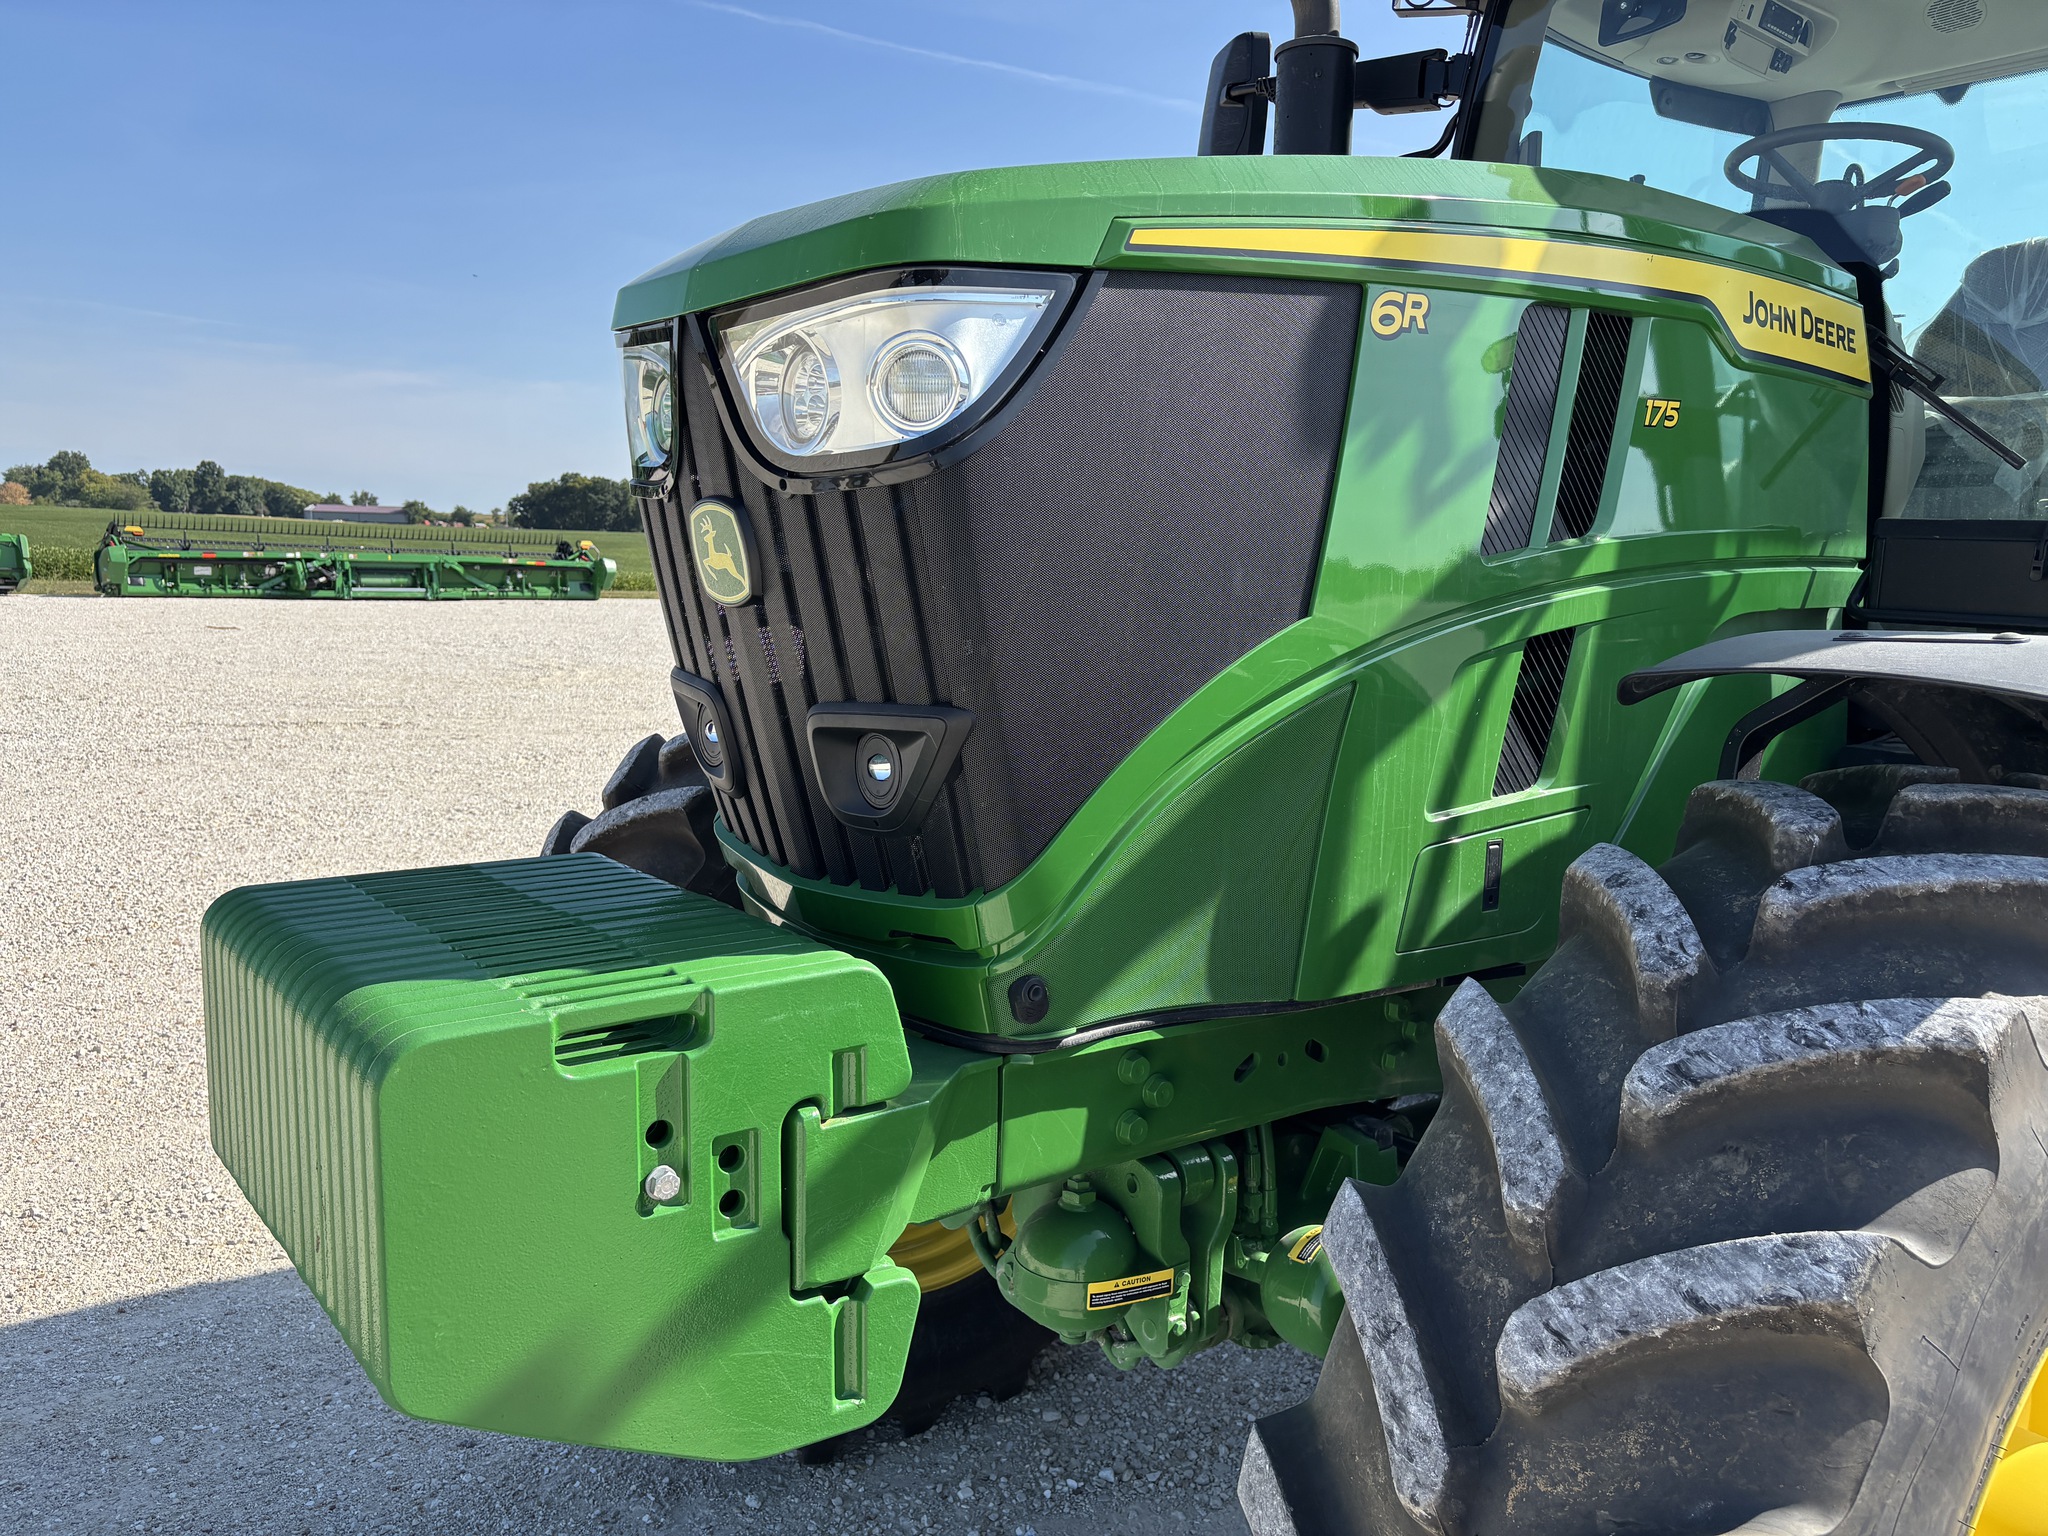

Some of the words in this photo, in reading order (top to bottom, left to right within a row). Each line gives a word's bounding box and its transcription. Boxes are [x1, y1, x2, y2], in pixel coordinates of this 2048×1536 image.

[1370, 290, 1430, 340] 6R
[1743, 290, 1796, 336] JOHN
[1801, 306, 1857, 354] DEERE
[1644, 399, 1681, 428] 175
[1121, 1276, 1151, 1287] CAUTION
